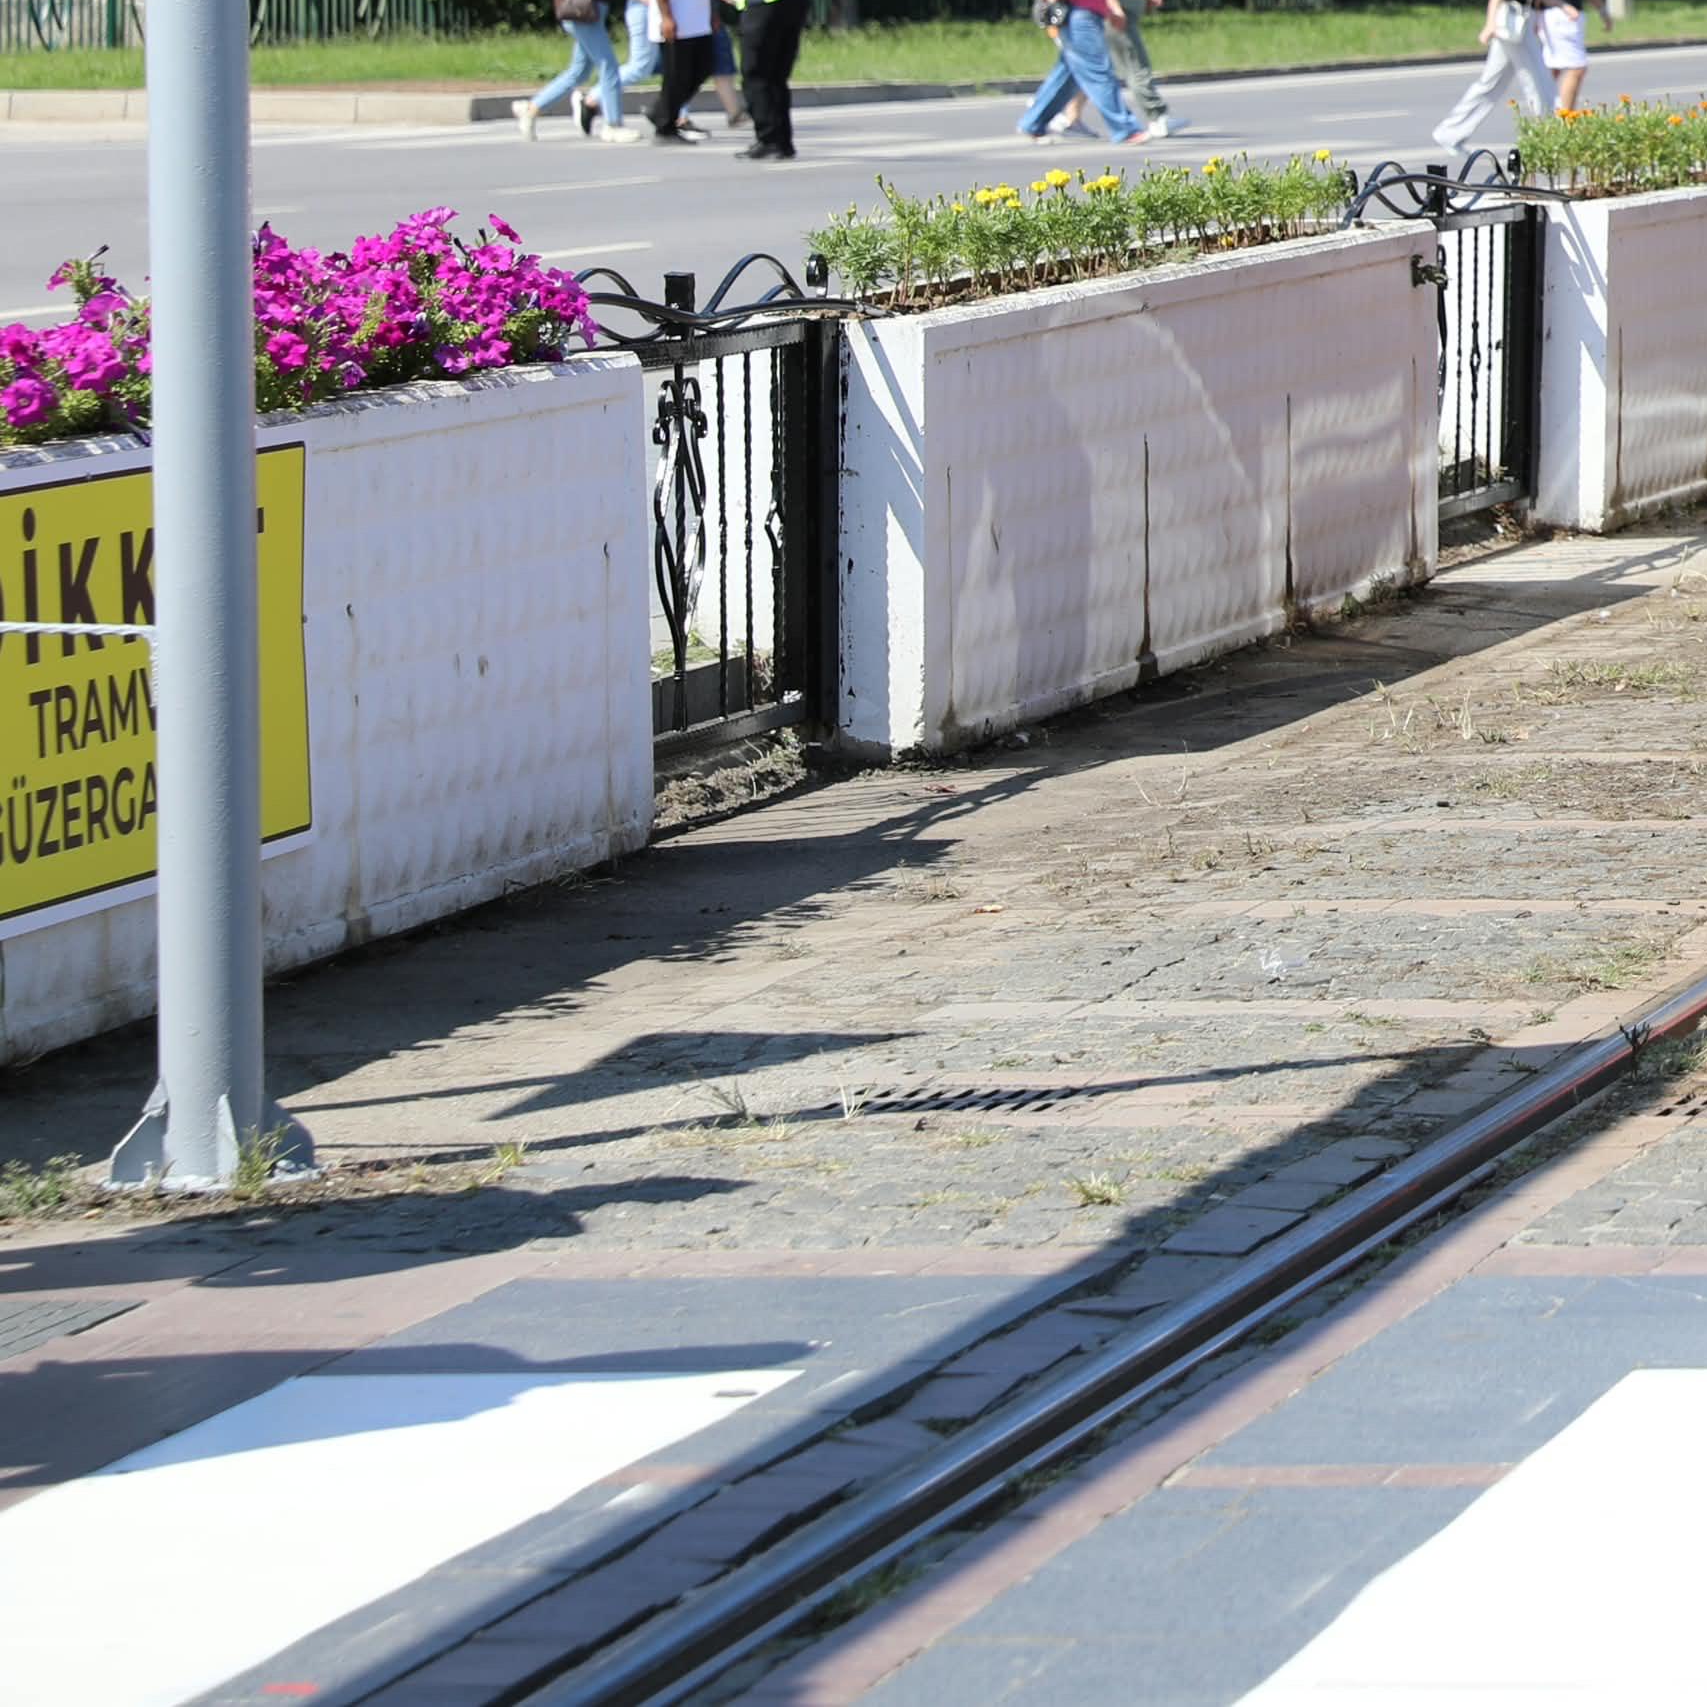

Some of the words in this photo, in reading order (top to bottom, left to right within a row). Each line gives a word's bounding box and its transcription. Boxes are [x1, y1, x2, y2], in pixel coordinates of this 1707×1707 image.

[0, 507, 264, 665] İKK
[29, 667, 156, 758] TRAMV
[0, 762, 157, 867] ÜZERGA
